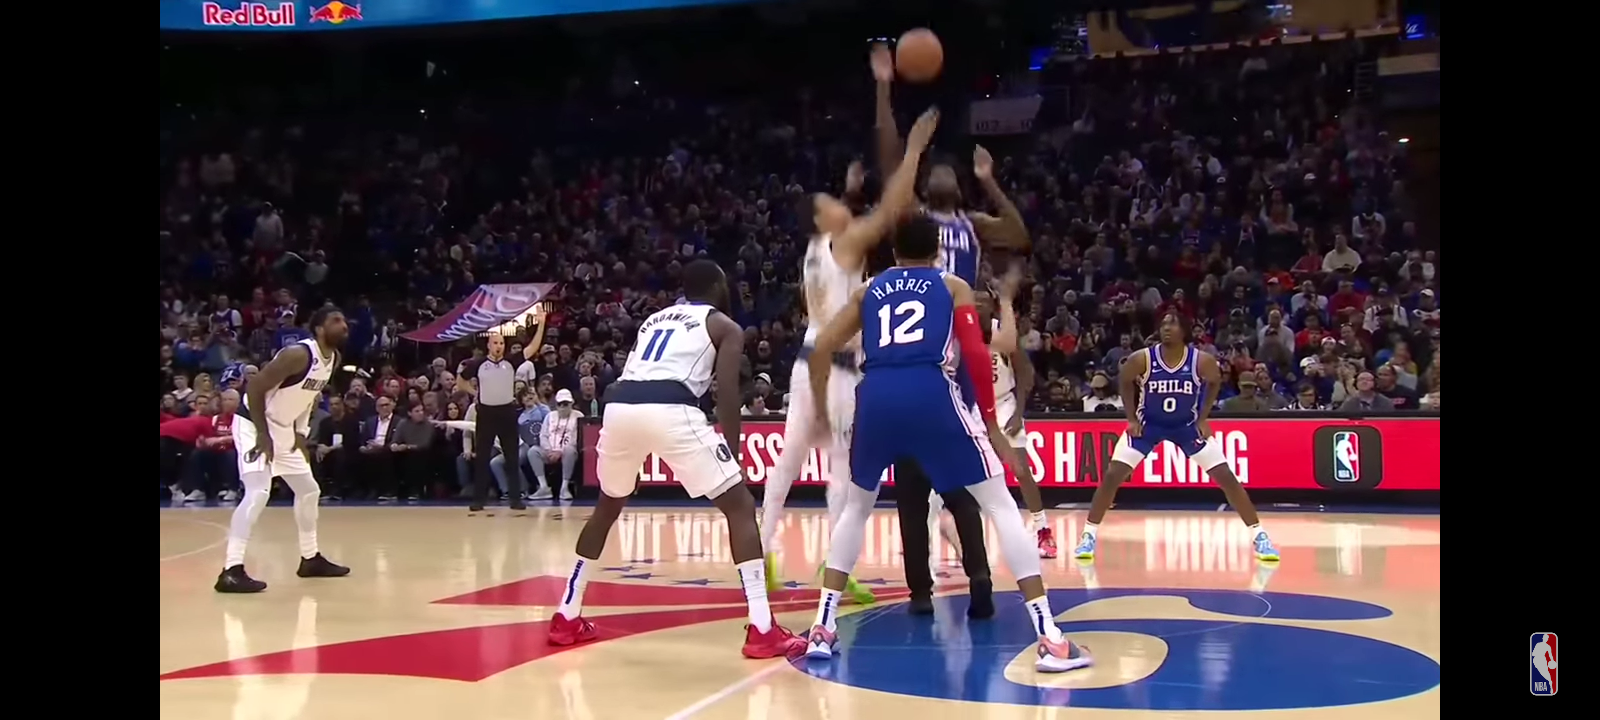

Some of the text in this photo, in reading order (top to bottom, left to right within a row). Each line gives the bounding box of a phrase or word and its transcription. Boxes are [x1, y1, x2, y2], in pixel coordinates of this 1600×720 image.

[203, 2, 295, 26] Red Bull
[872, 278, 932, 300] HARRIS
[878, 300, 925, 348] 12
[640, 328, 675, 362] 11
[1148, 379, 1194, 395] PHILA
[1162, 397, 1177, 413] 0
